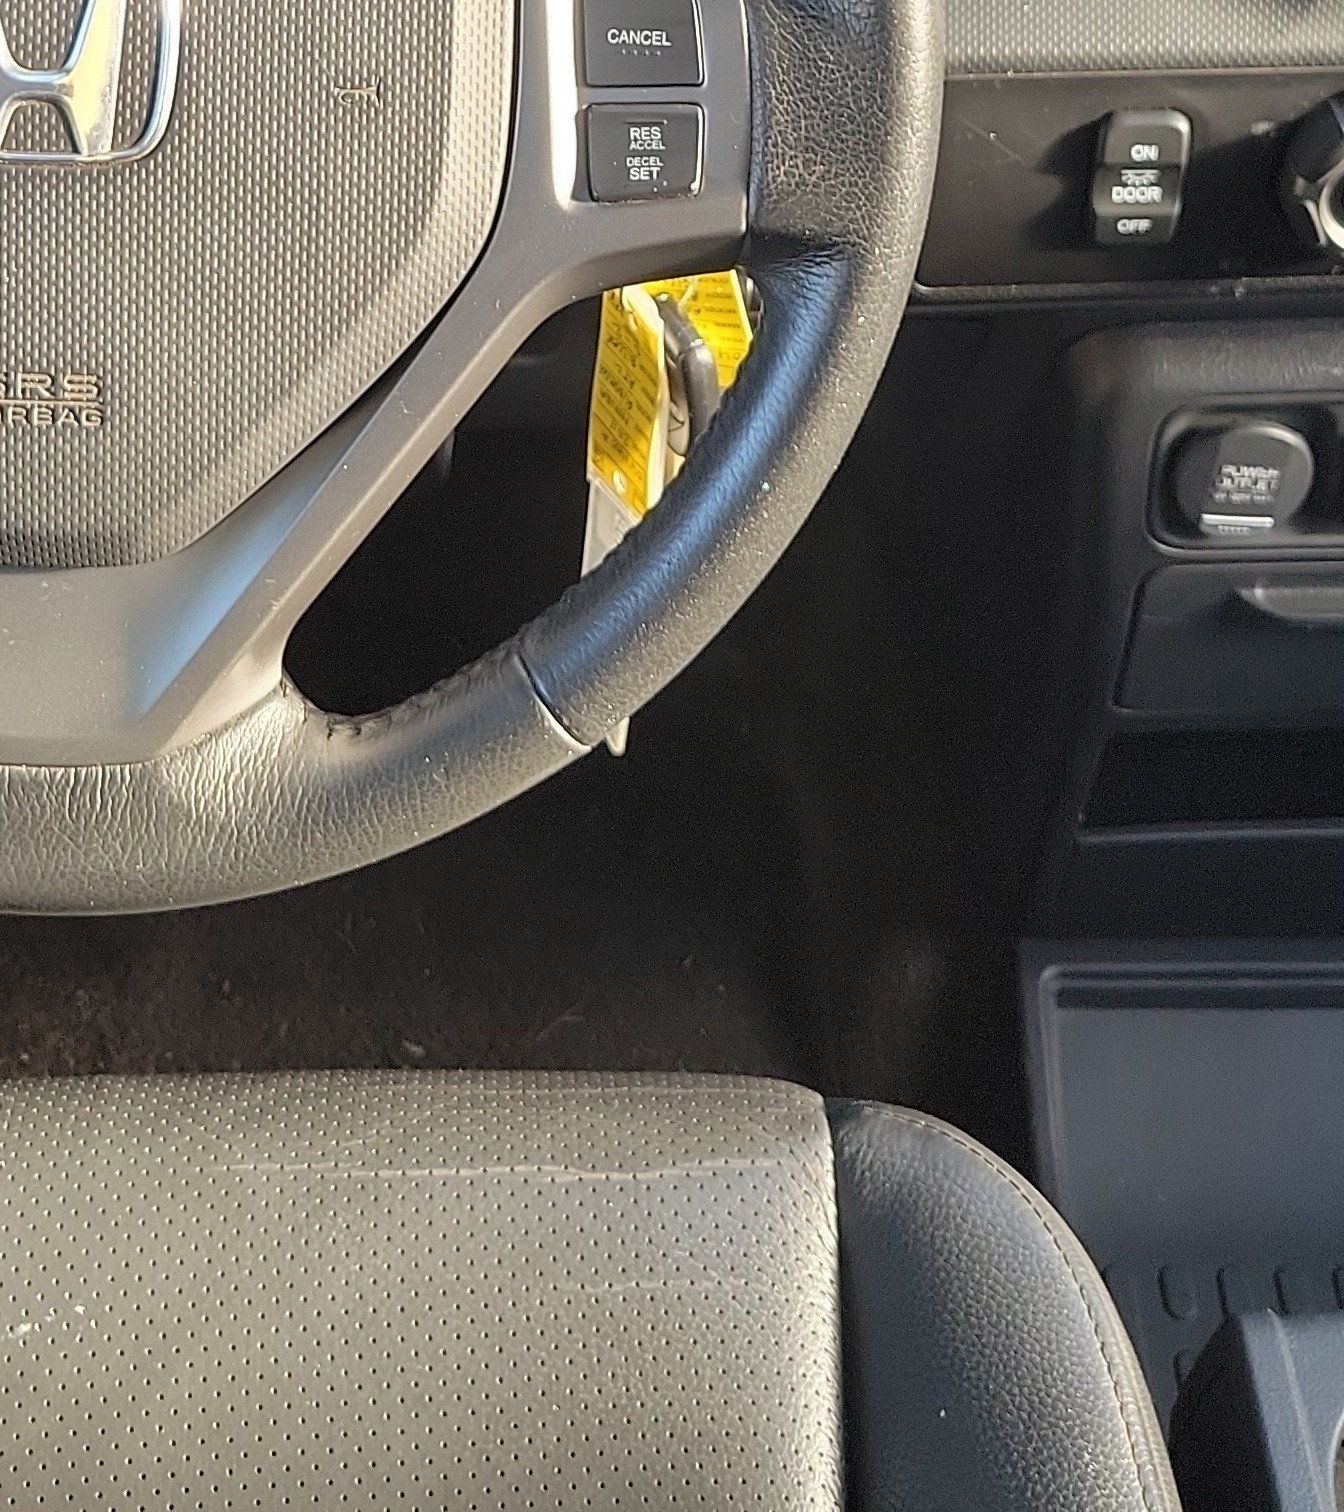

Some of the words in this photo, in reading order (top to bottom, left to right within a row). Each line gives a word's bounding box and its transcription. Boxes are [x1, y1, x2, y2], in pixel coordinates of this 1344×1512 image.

[607, 27, 672, 47] CANCEL
[629, 126, 662, 140] RES
[629, 140, 666, 151] ACCEL
[1130, 144, 1159, 162] ON
[626, 156, 664, 168] DECEL
[629, 167, 660, 181] SET
[1111, 185, 1164, 204] DOOR
[1117, 218, 1154, 235] OFF
